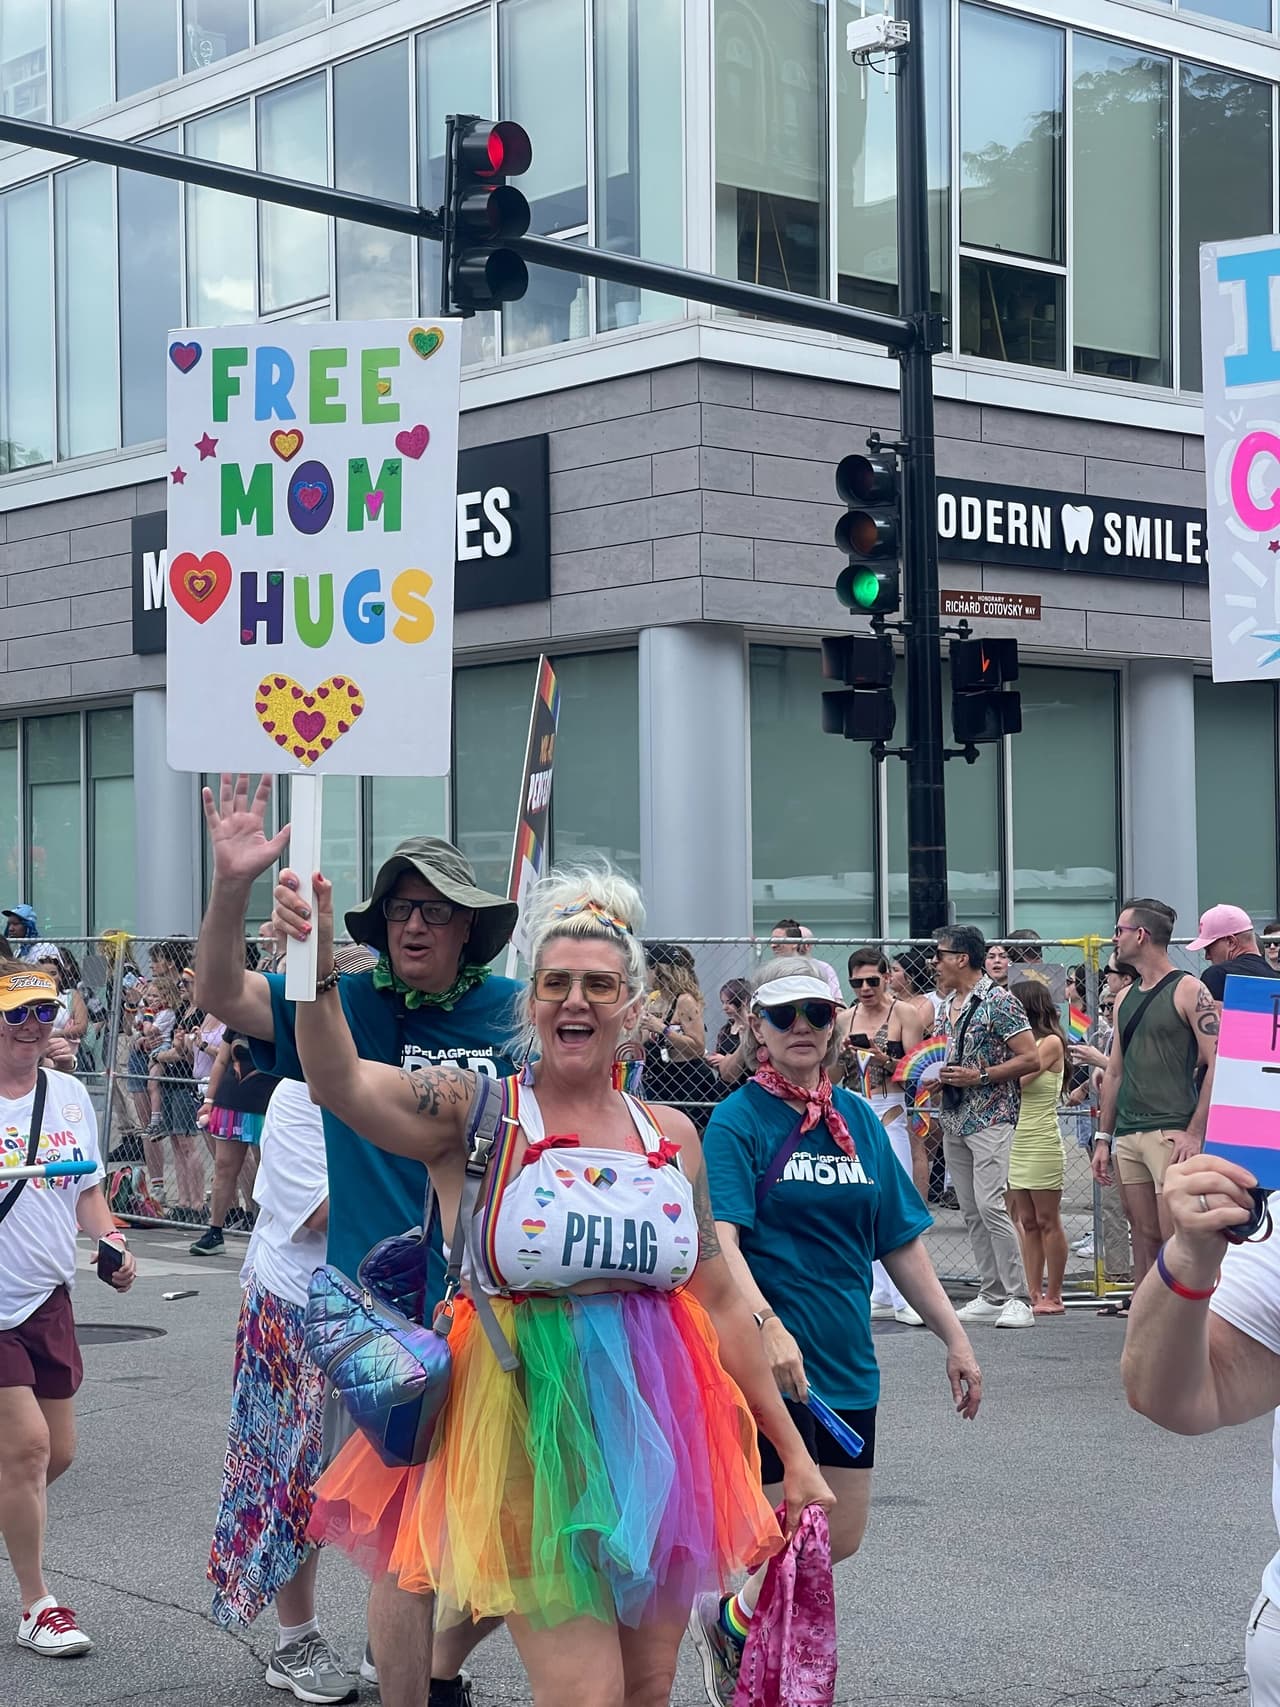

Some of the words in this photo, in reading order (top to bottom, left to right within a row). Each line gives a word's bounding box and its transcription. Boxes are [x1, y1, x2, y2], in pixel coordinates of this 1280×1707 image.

[212, 346, 401, 424] FREE
[220, 458, 402, 537] MOM
[457, 486, 512, 561] ES
[937, 493, 1051, 550] ODERN
[1103, 512, 1208, 565] SMILE
[240, 568, 435, 648] HUGS
[945, 600, 981, 614] RICHARD
[983, 602, 1023, 617] COTOVSKY
[1025, 607, 1036, 615] WAY
[783, 1159, 868, 1185] MOM
[789, 1151, 861, 1164] PFLGProud
[561, 1211, 658, 1275] PFLAG
